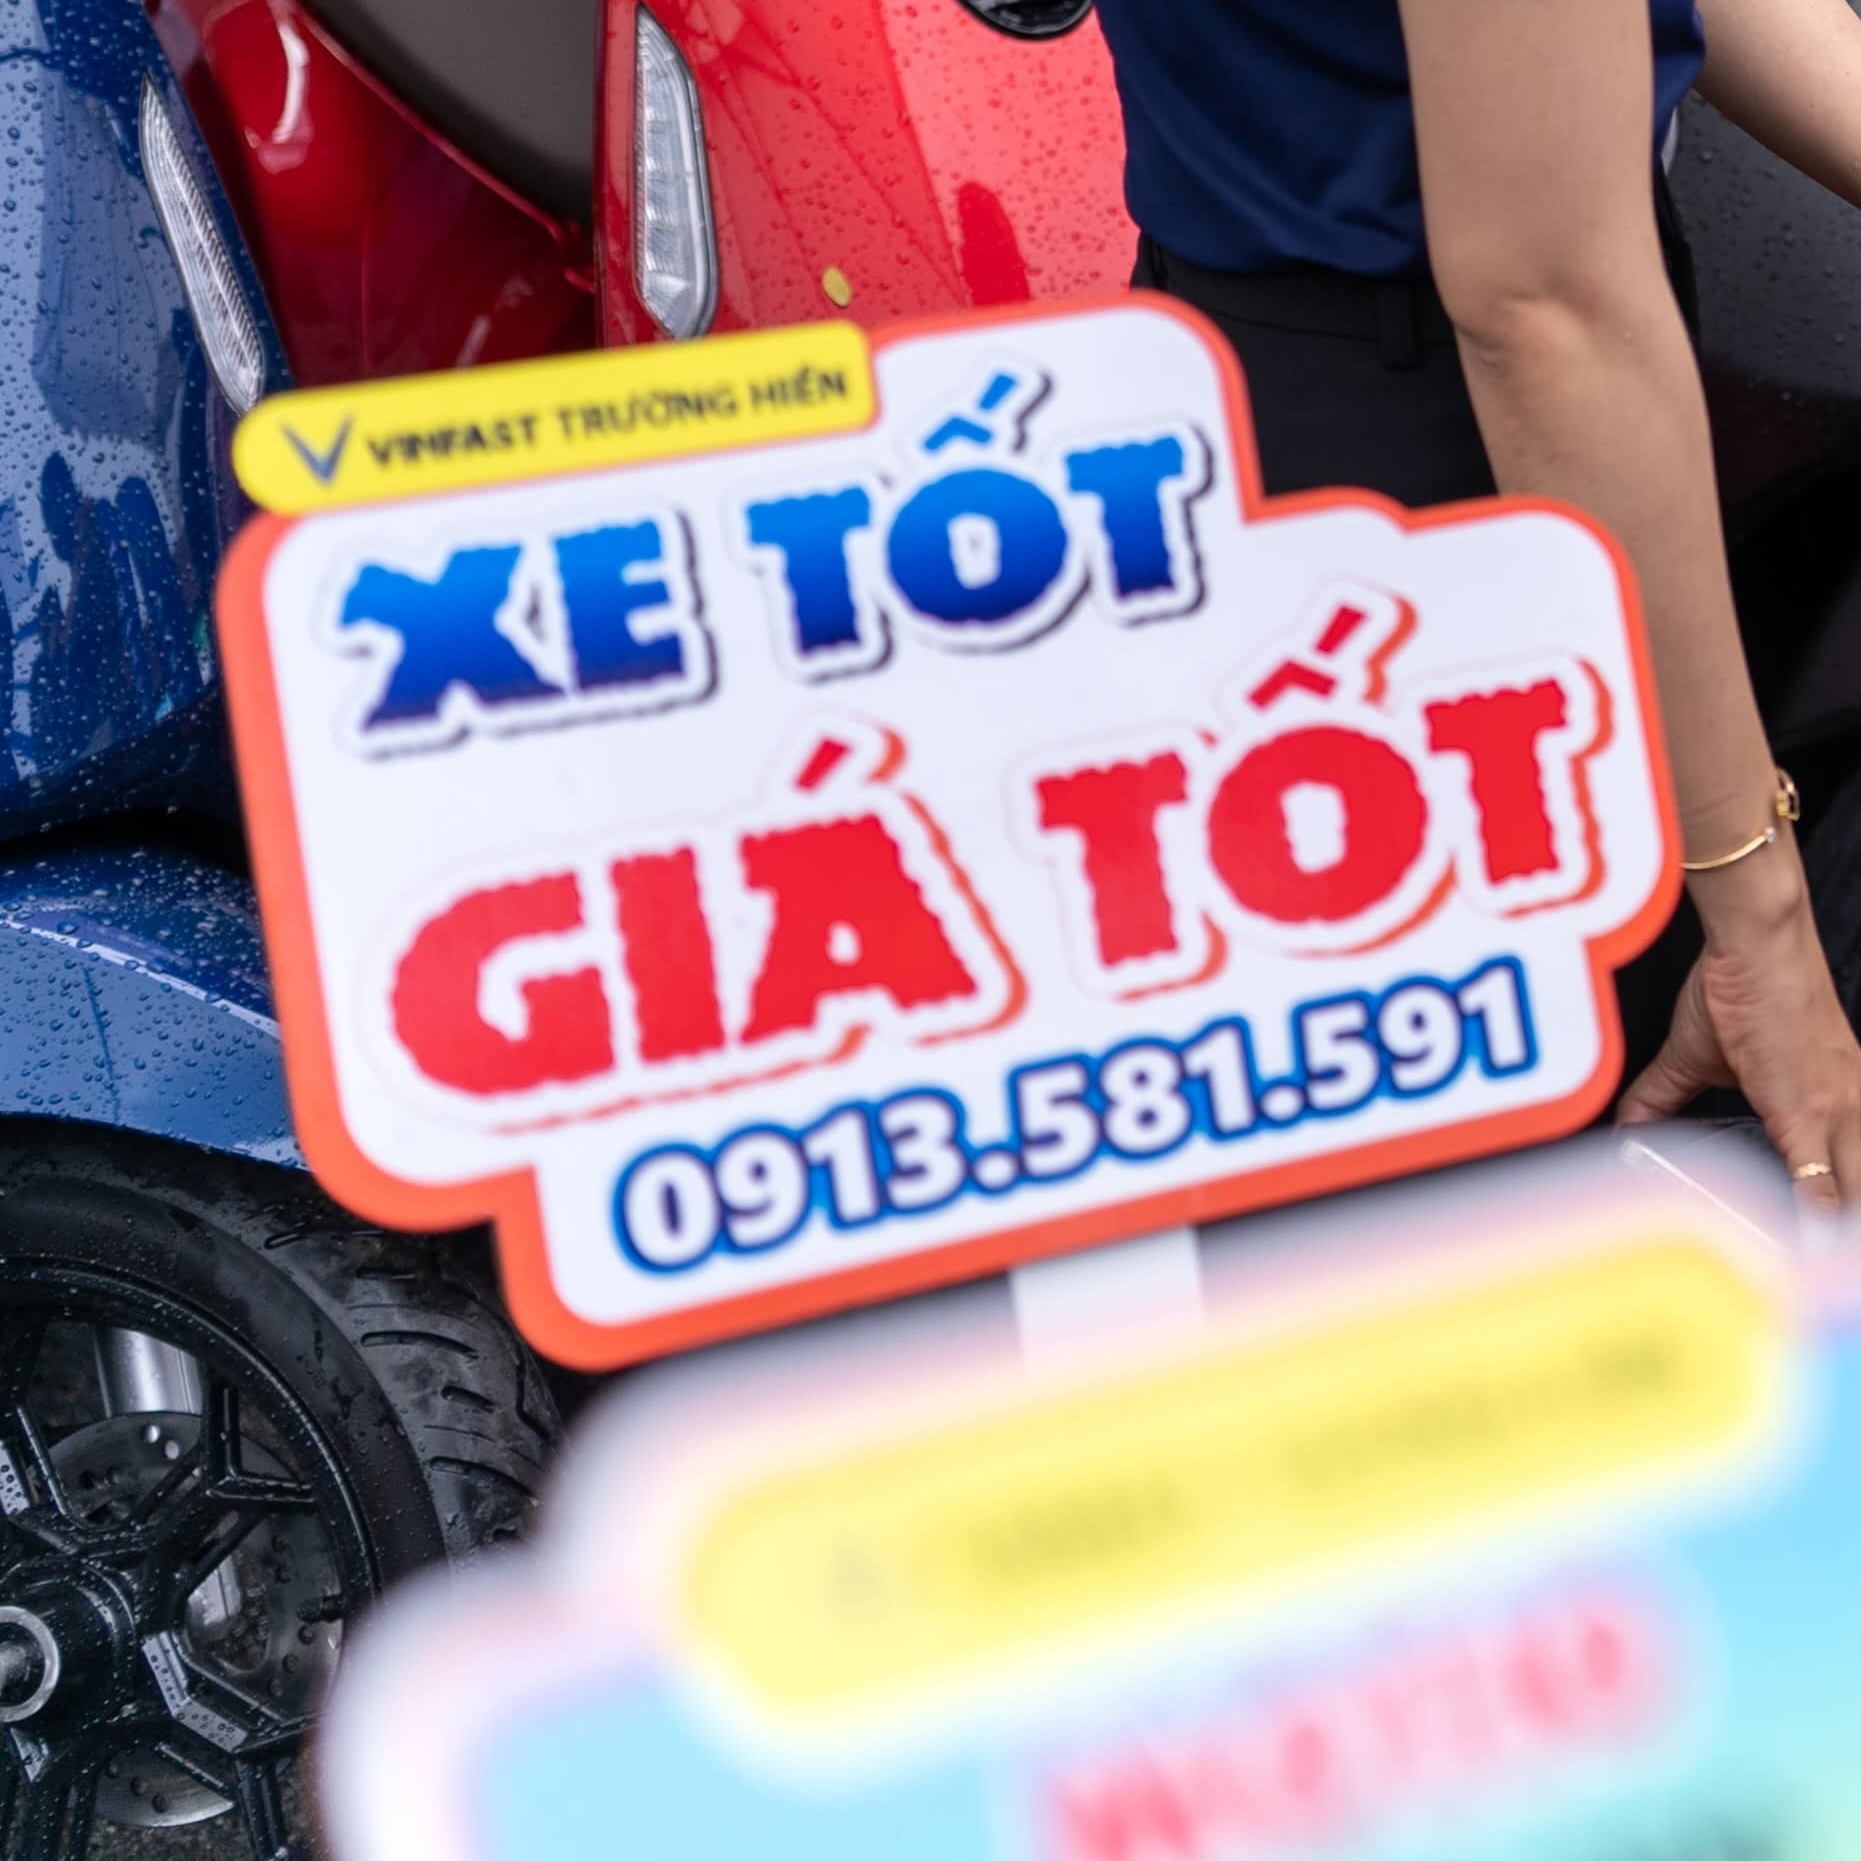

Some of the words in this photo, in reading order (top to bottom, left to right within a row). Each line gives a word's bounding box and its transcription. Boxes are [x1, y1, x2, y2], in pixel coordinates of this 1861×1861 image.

[339, 519, 687, 734] XE
[745, 372, 1185, 658] TỐT
[369, 413, 540, 468] VINFAST
[390, 736, 981, 1099] GIÁ
[1036, 604, 1569, 970] TỐT
[613, 955, 1539, 1277] 0913.581.591
